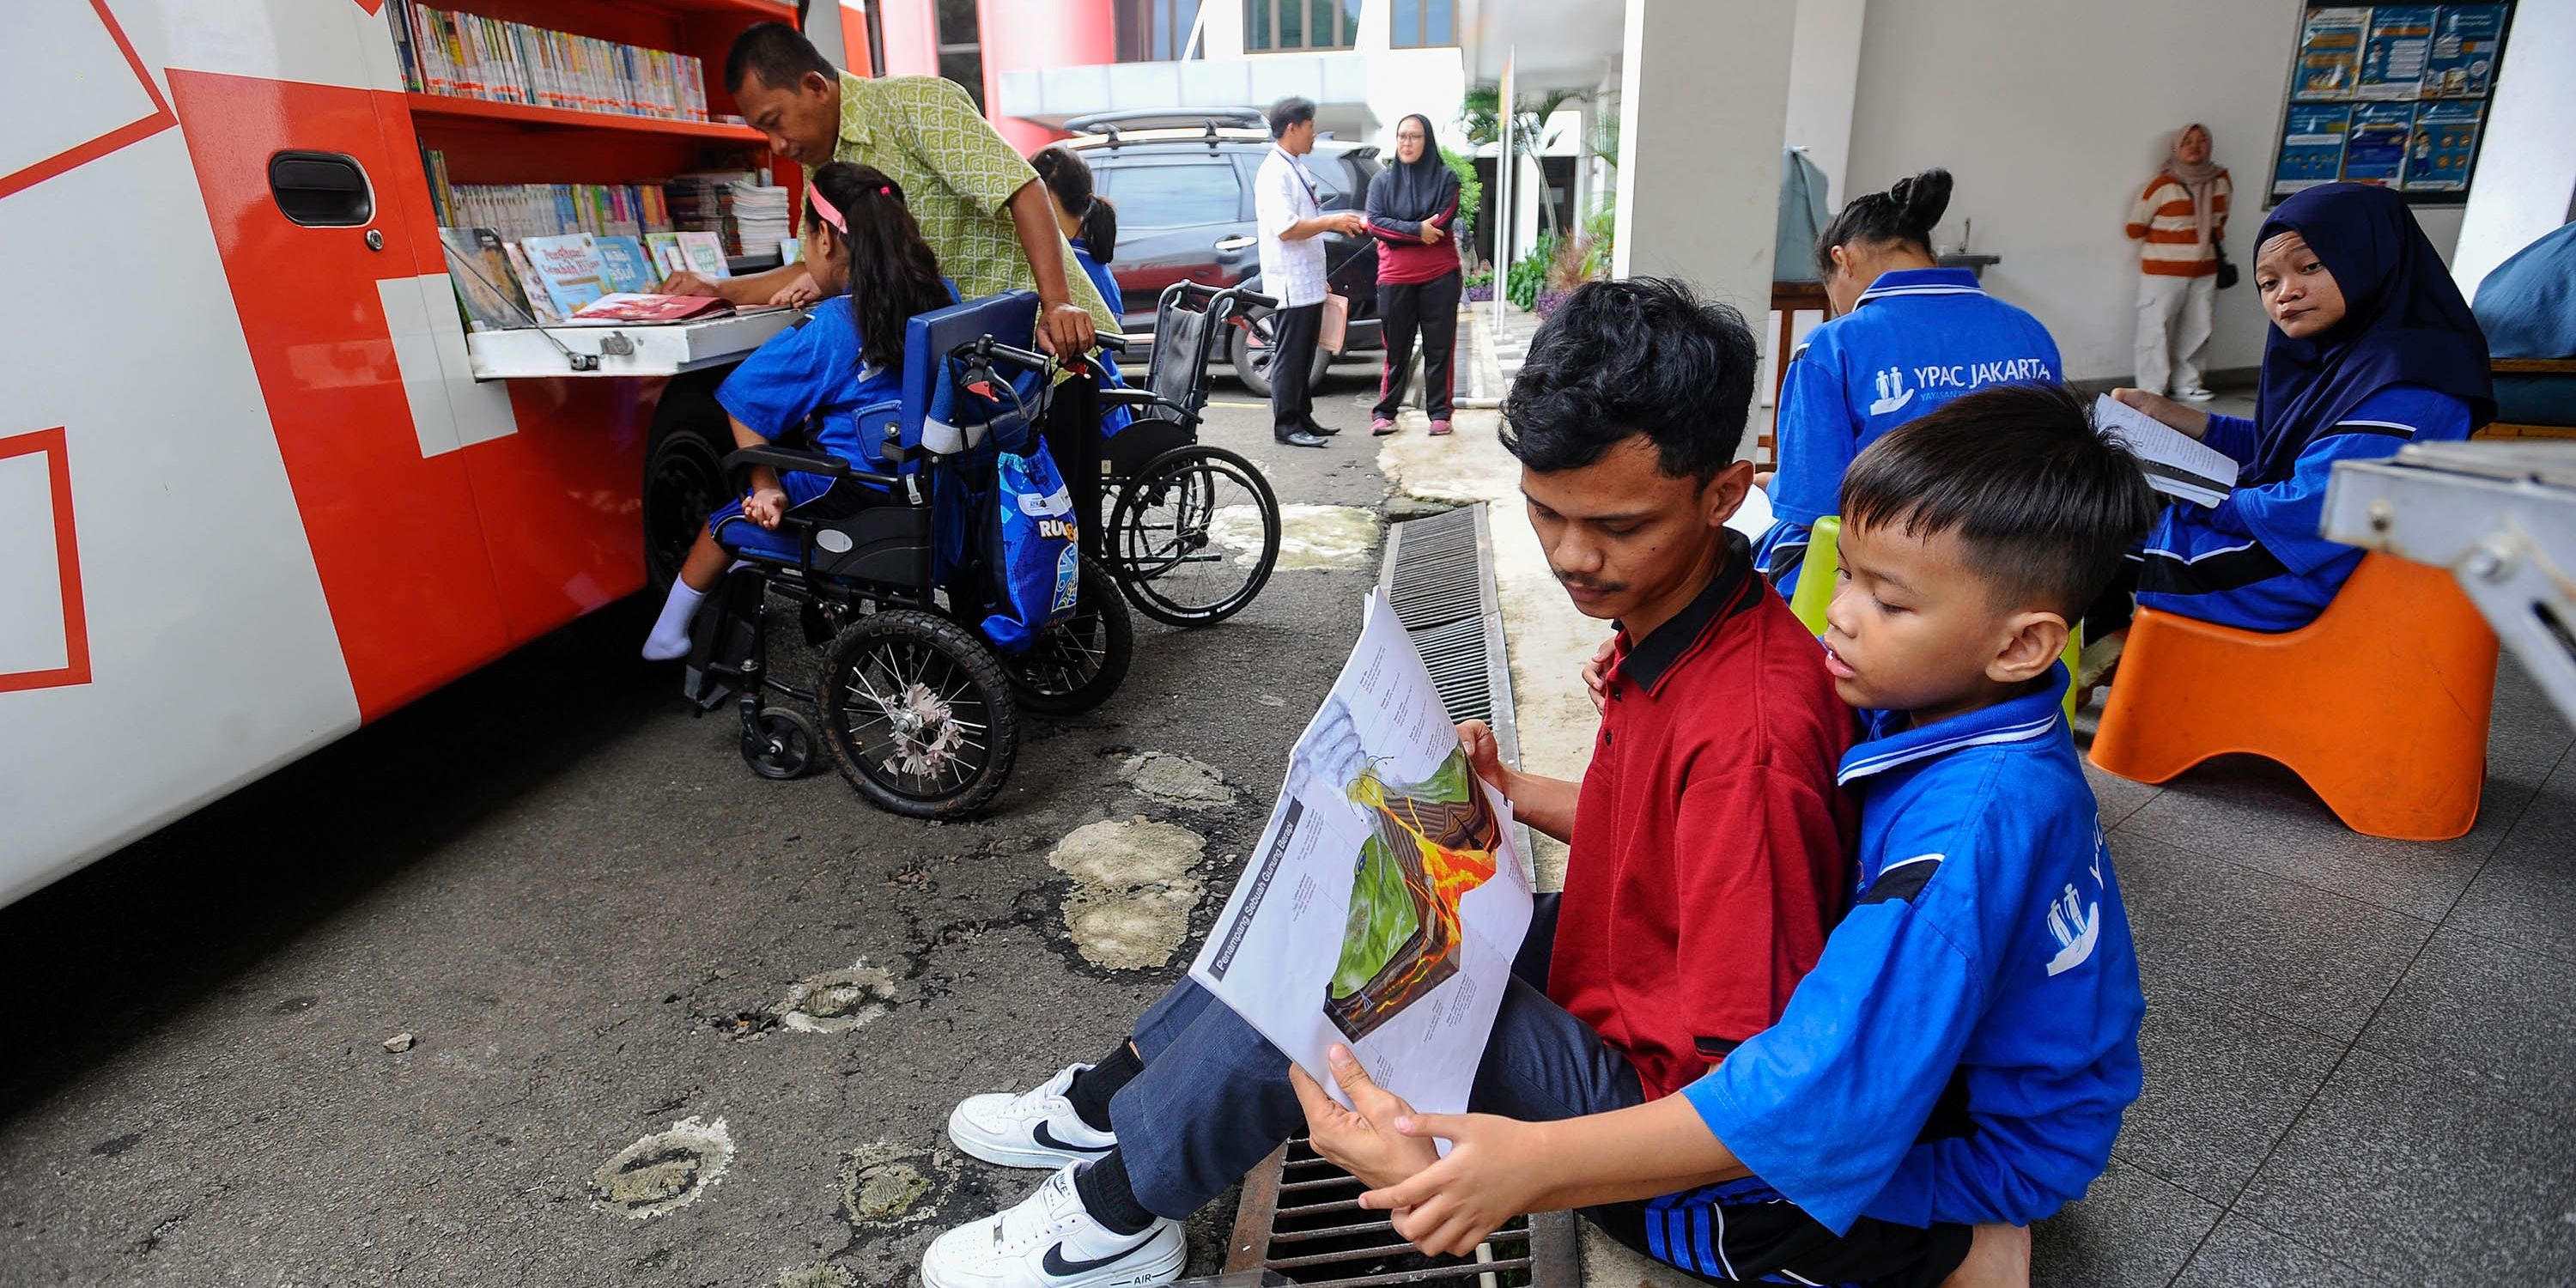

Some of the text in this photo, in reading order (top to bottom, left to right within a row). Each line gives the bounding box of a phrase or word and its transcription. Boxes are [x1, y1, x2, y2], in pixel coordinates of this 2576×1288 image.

[1914, 358, 2051, 390] YPAC JAKARTA
[1919, 388, 1959, 402] YAYASAN
[1216, 821, 1294, 971] Penampang Sebuah Gunung Berapi
[1058, 1172, 1069, 1194] NIKE
[1133, 1273, 1151, 1285] AIR
